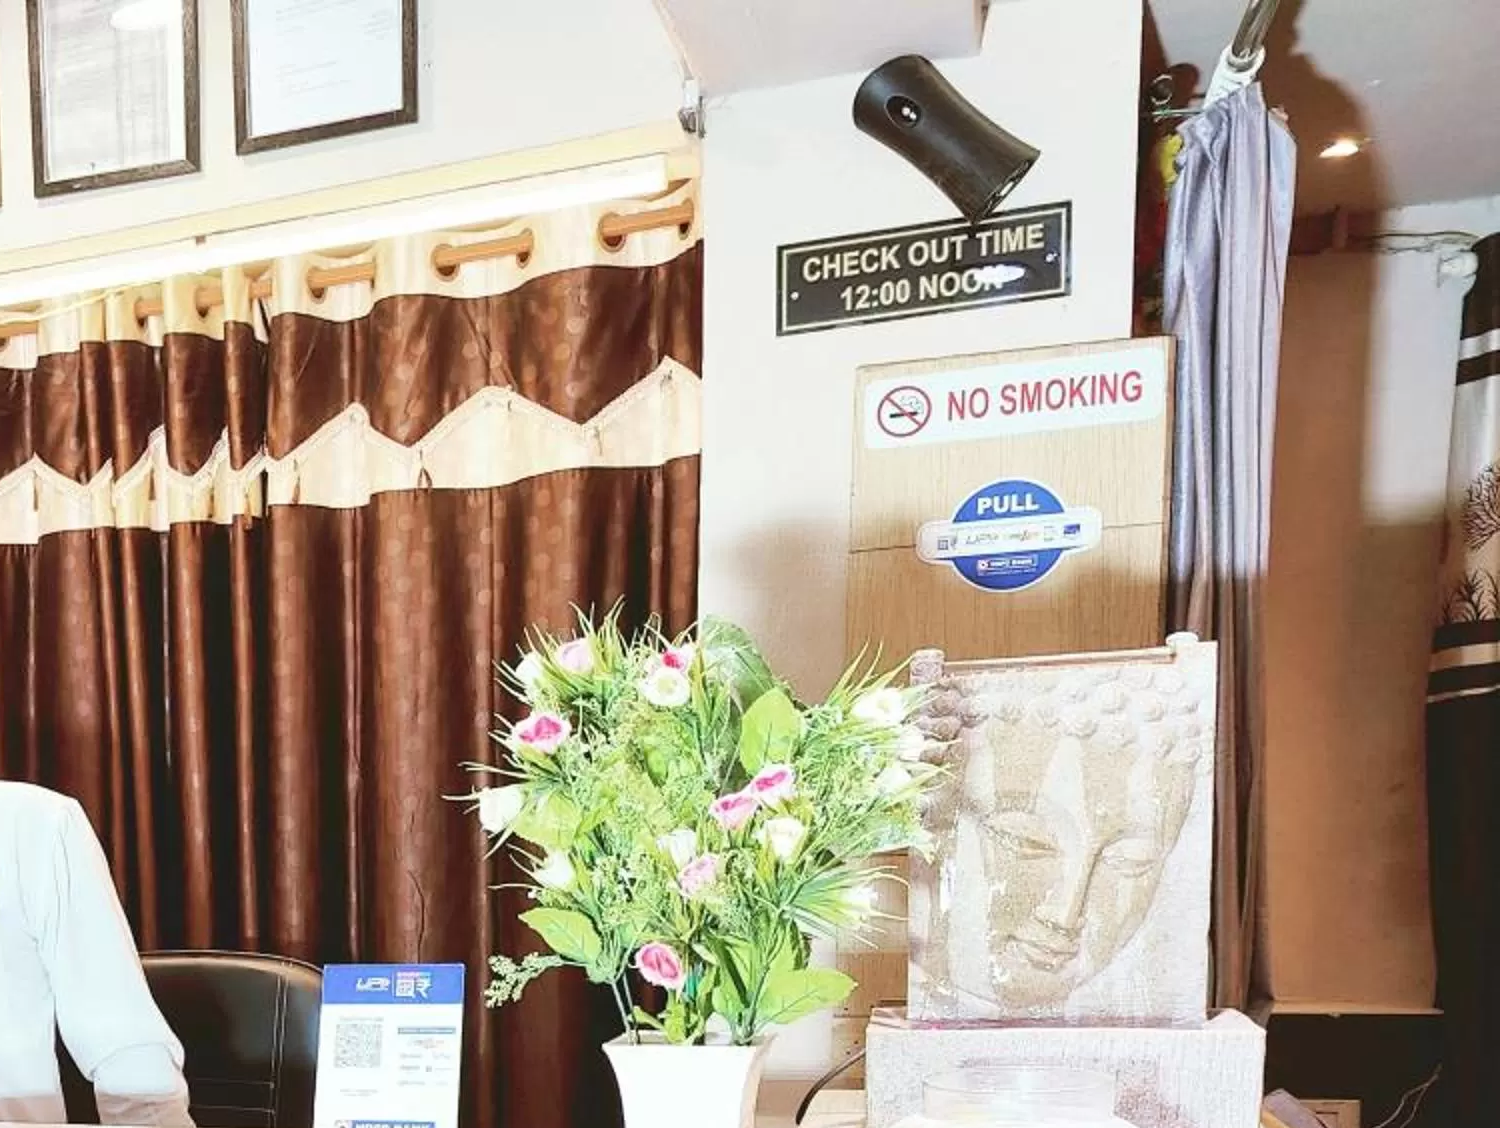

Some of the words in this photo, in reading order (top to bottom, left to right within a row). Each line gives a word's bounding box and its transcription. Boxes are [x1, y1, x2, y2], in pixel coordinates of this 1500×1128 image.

[802, 244, 900, 283] CHECK
[907, 233, 969, 267] OUT
[975, 222, 1045, 257] TIME
[840, 278, 911, 311] 12:00
[947, 387, 990, 422] NO
[998, 369, 1144, 416] SMOKING
[976, 492, 1041, 515] PULL
